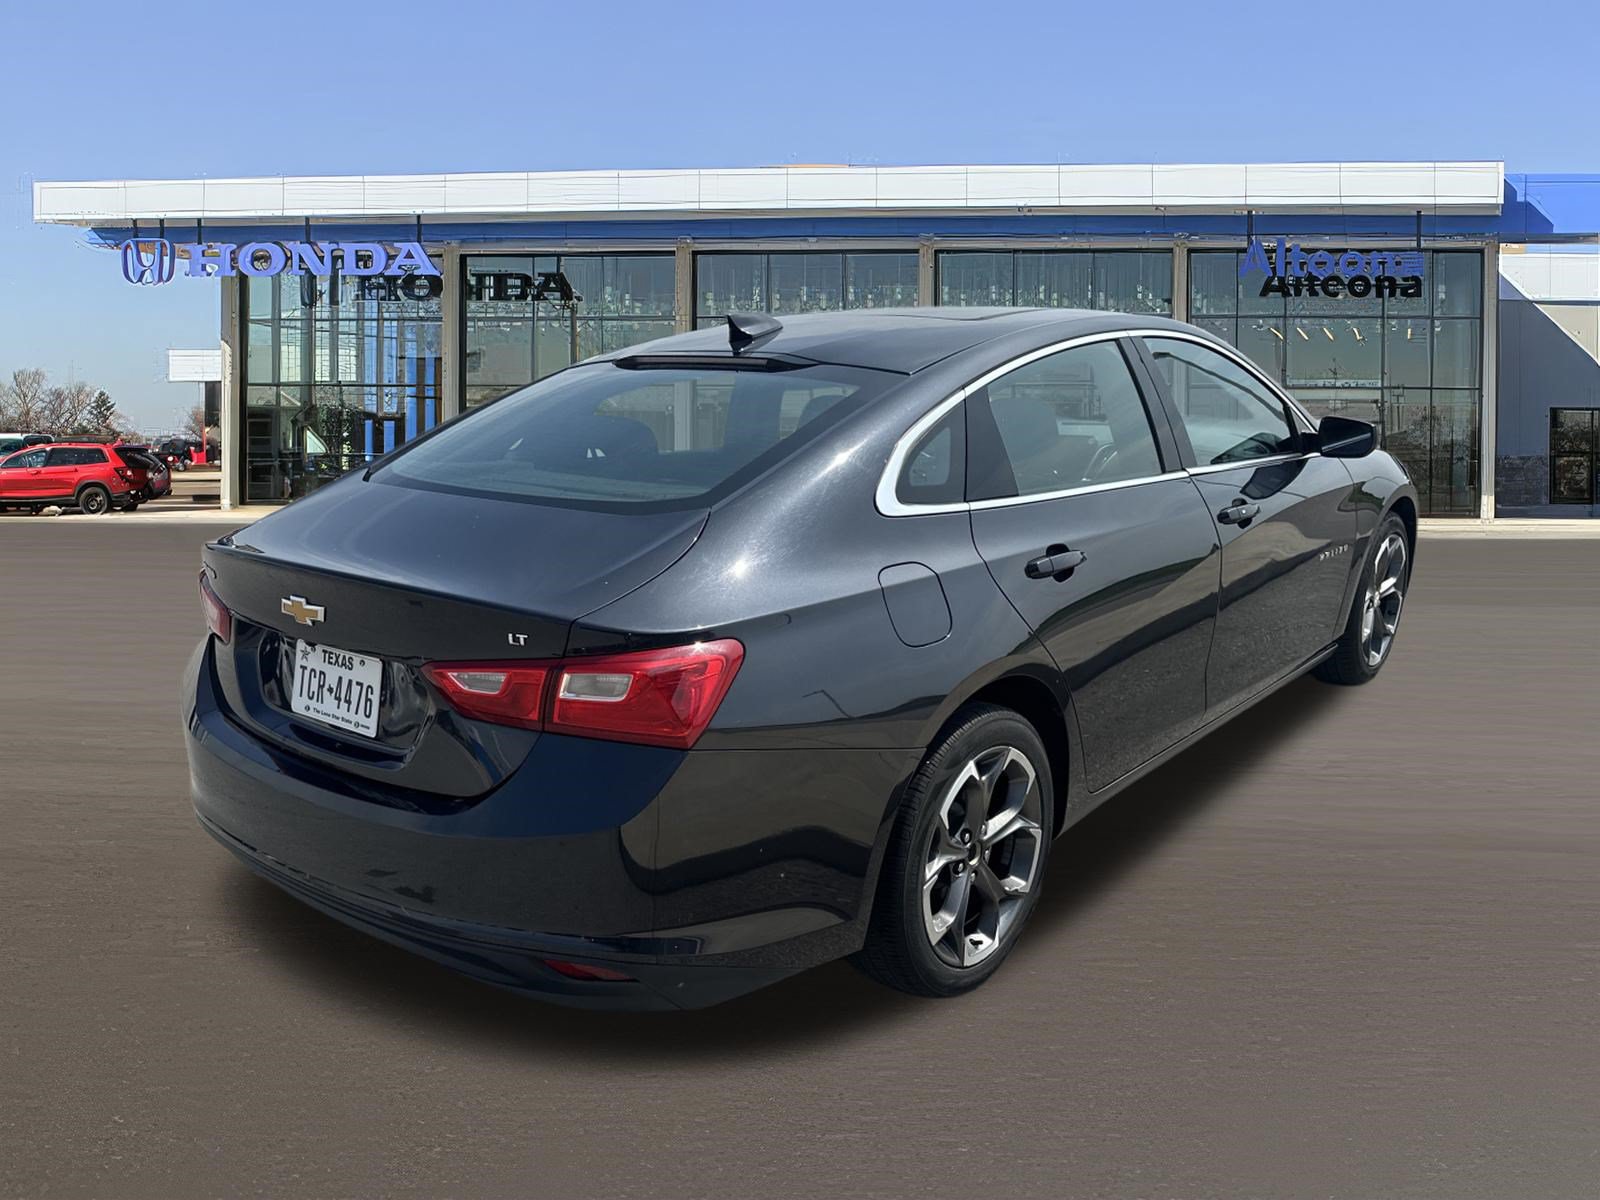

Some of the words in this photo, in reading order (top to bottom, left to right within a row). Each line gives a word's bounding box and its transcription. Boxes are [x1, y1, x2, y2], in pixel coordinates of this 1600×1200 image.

[185, 241, 442, 277] HONDA
[508, 633, 528, 646] LT
[321, 649, 354, 671] TEXAS
